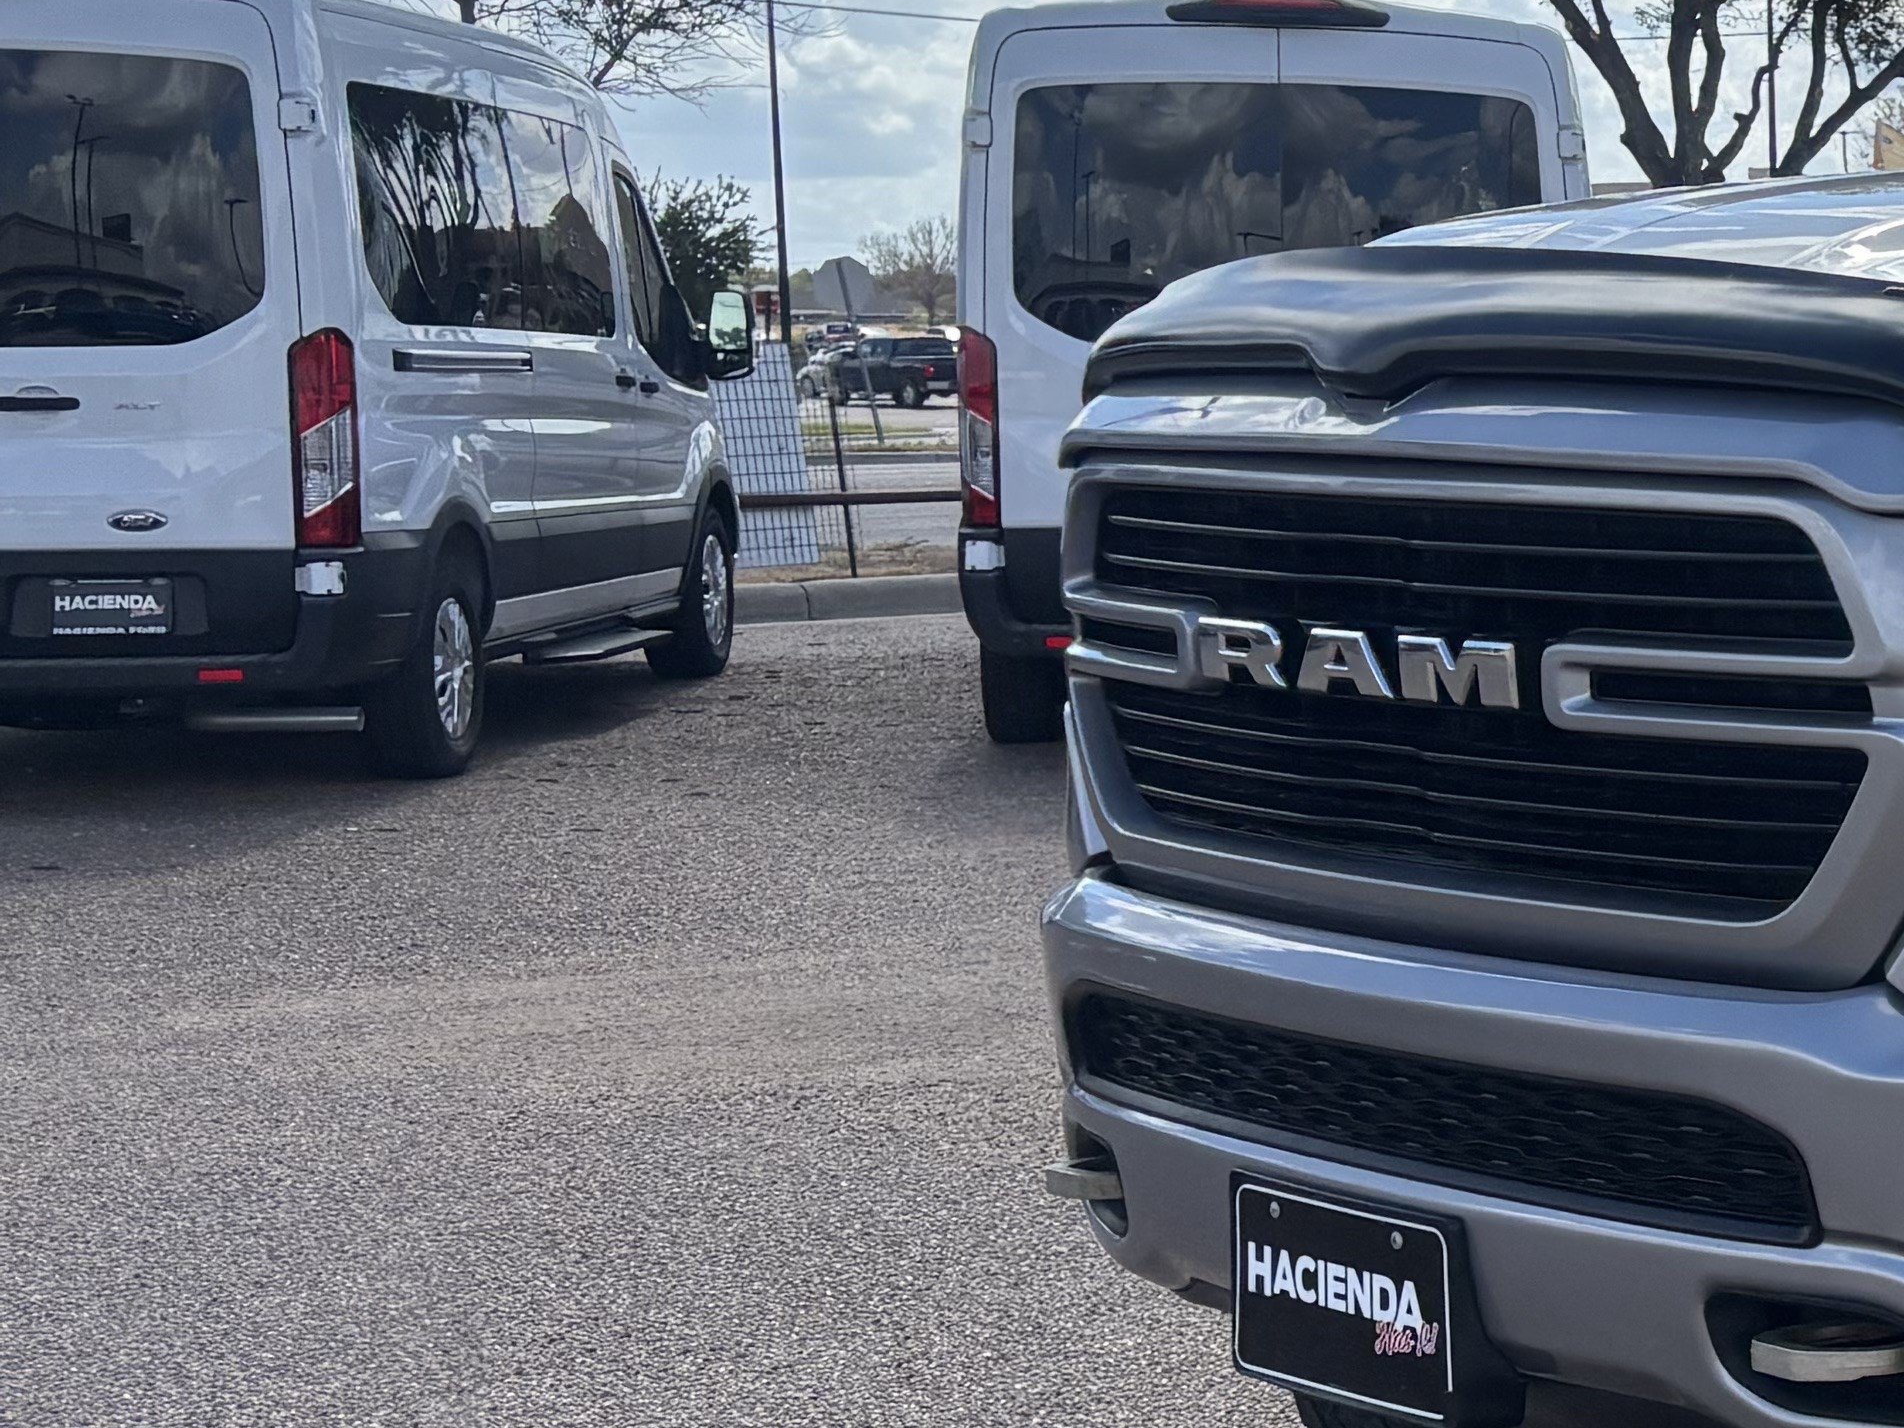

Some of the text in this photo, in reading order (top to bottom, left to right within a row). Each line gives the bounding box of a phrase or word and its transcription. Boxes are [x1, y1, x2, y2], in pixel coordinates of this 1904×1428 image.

[54, 594, 158, 612] HACIENDA
[1198, 615, 1521, 711] RAM
[1247, 1240, 1424, 1332] HACIENDA
